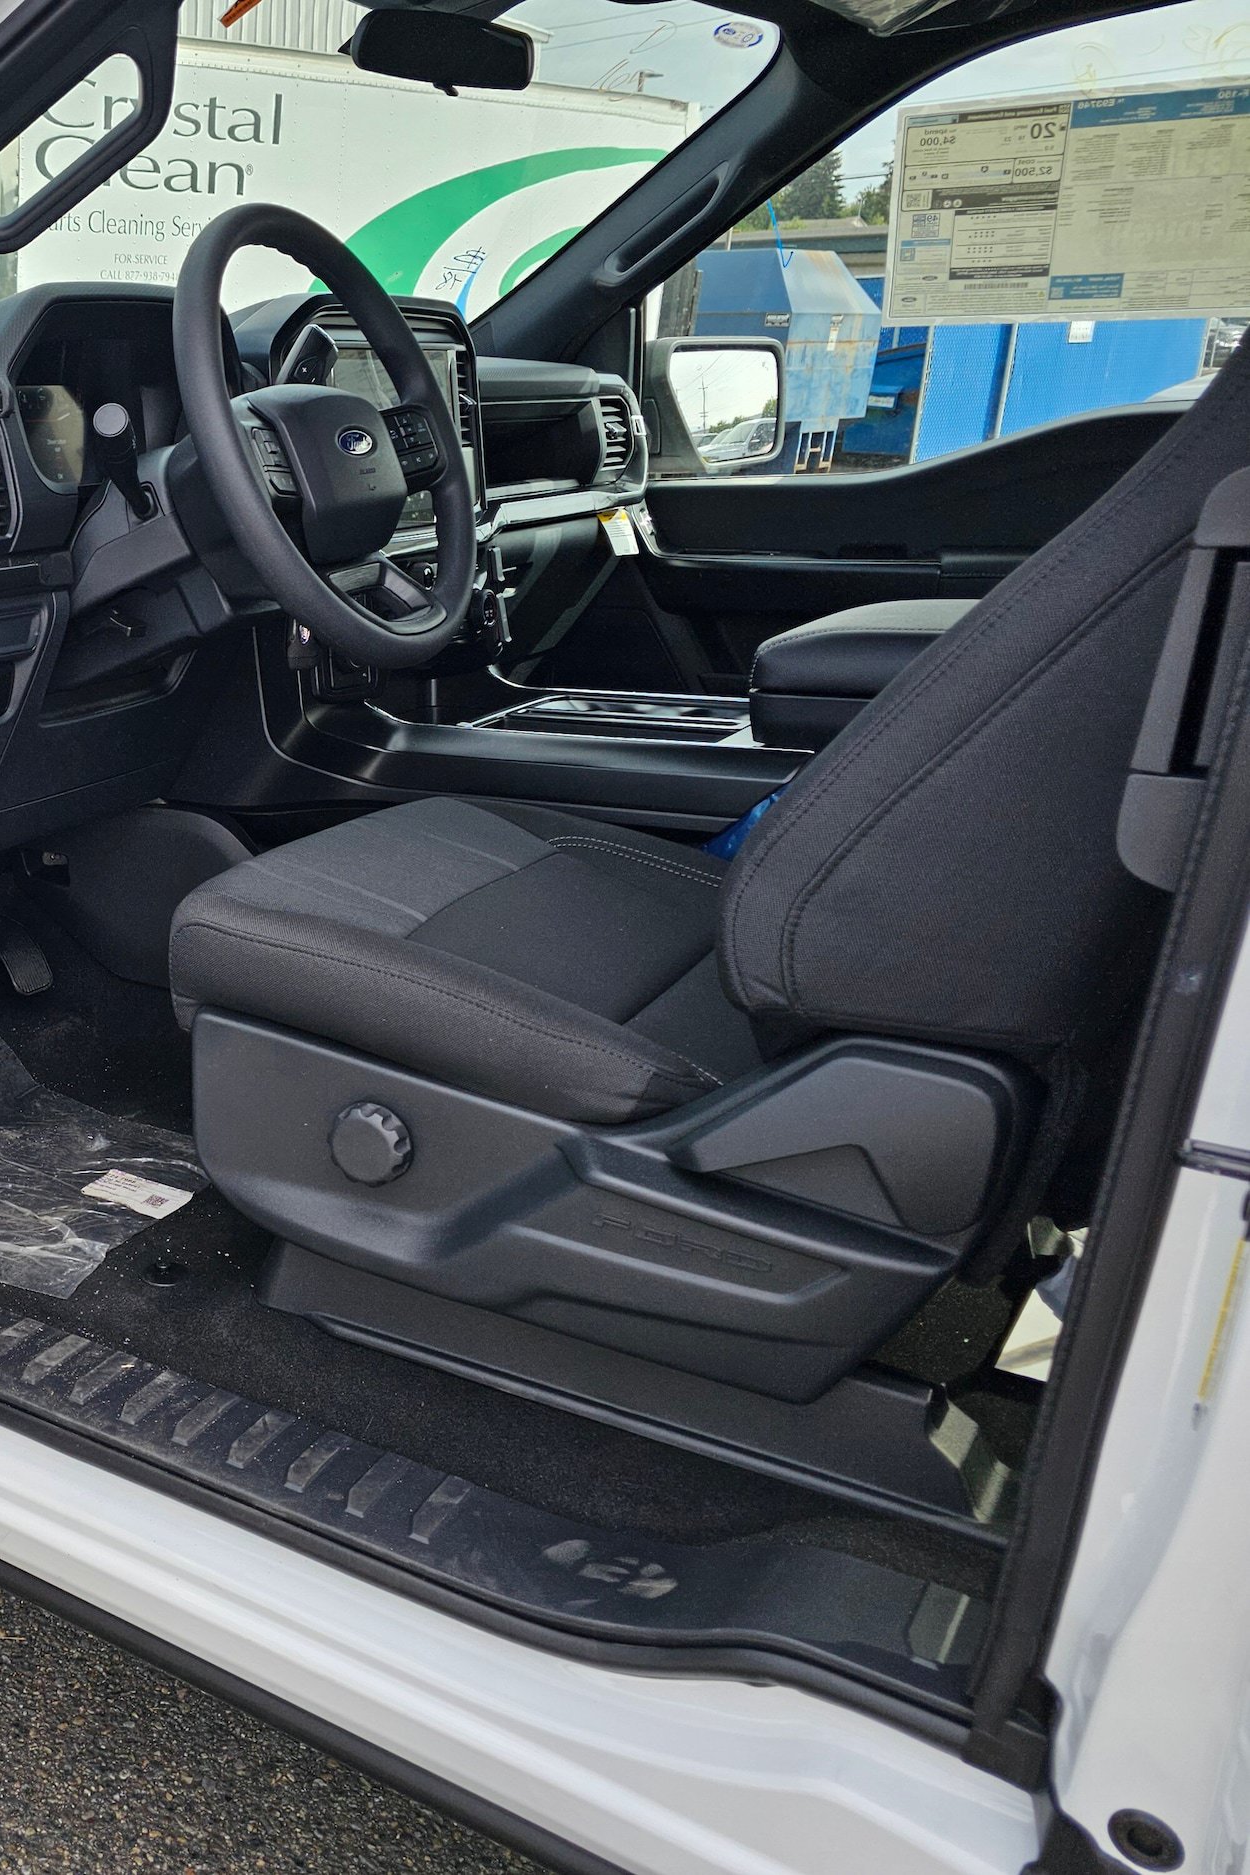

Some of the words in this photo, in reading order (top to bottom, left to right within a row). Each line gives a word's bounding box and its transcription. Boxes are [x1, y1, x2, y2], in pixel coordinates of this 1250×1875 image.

[43, 79, 283, 144] Crstal
[35, 135, 244, 196] Cean
[88, 210, 165, 242] Cleaning
[100, 270, 122, 280] CALL
[114, 254, 132, 264] FOR
[134, 255, 168, 265] SERVICE
